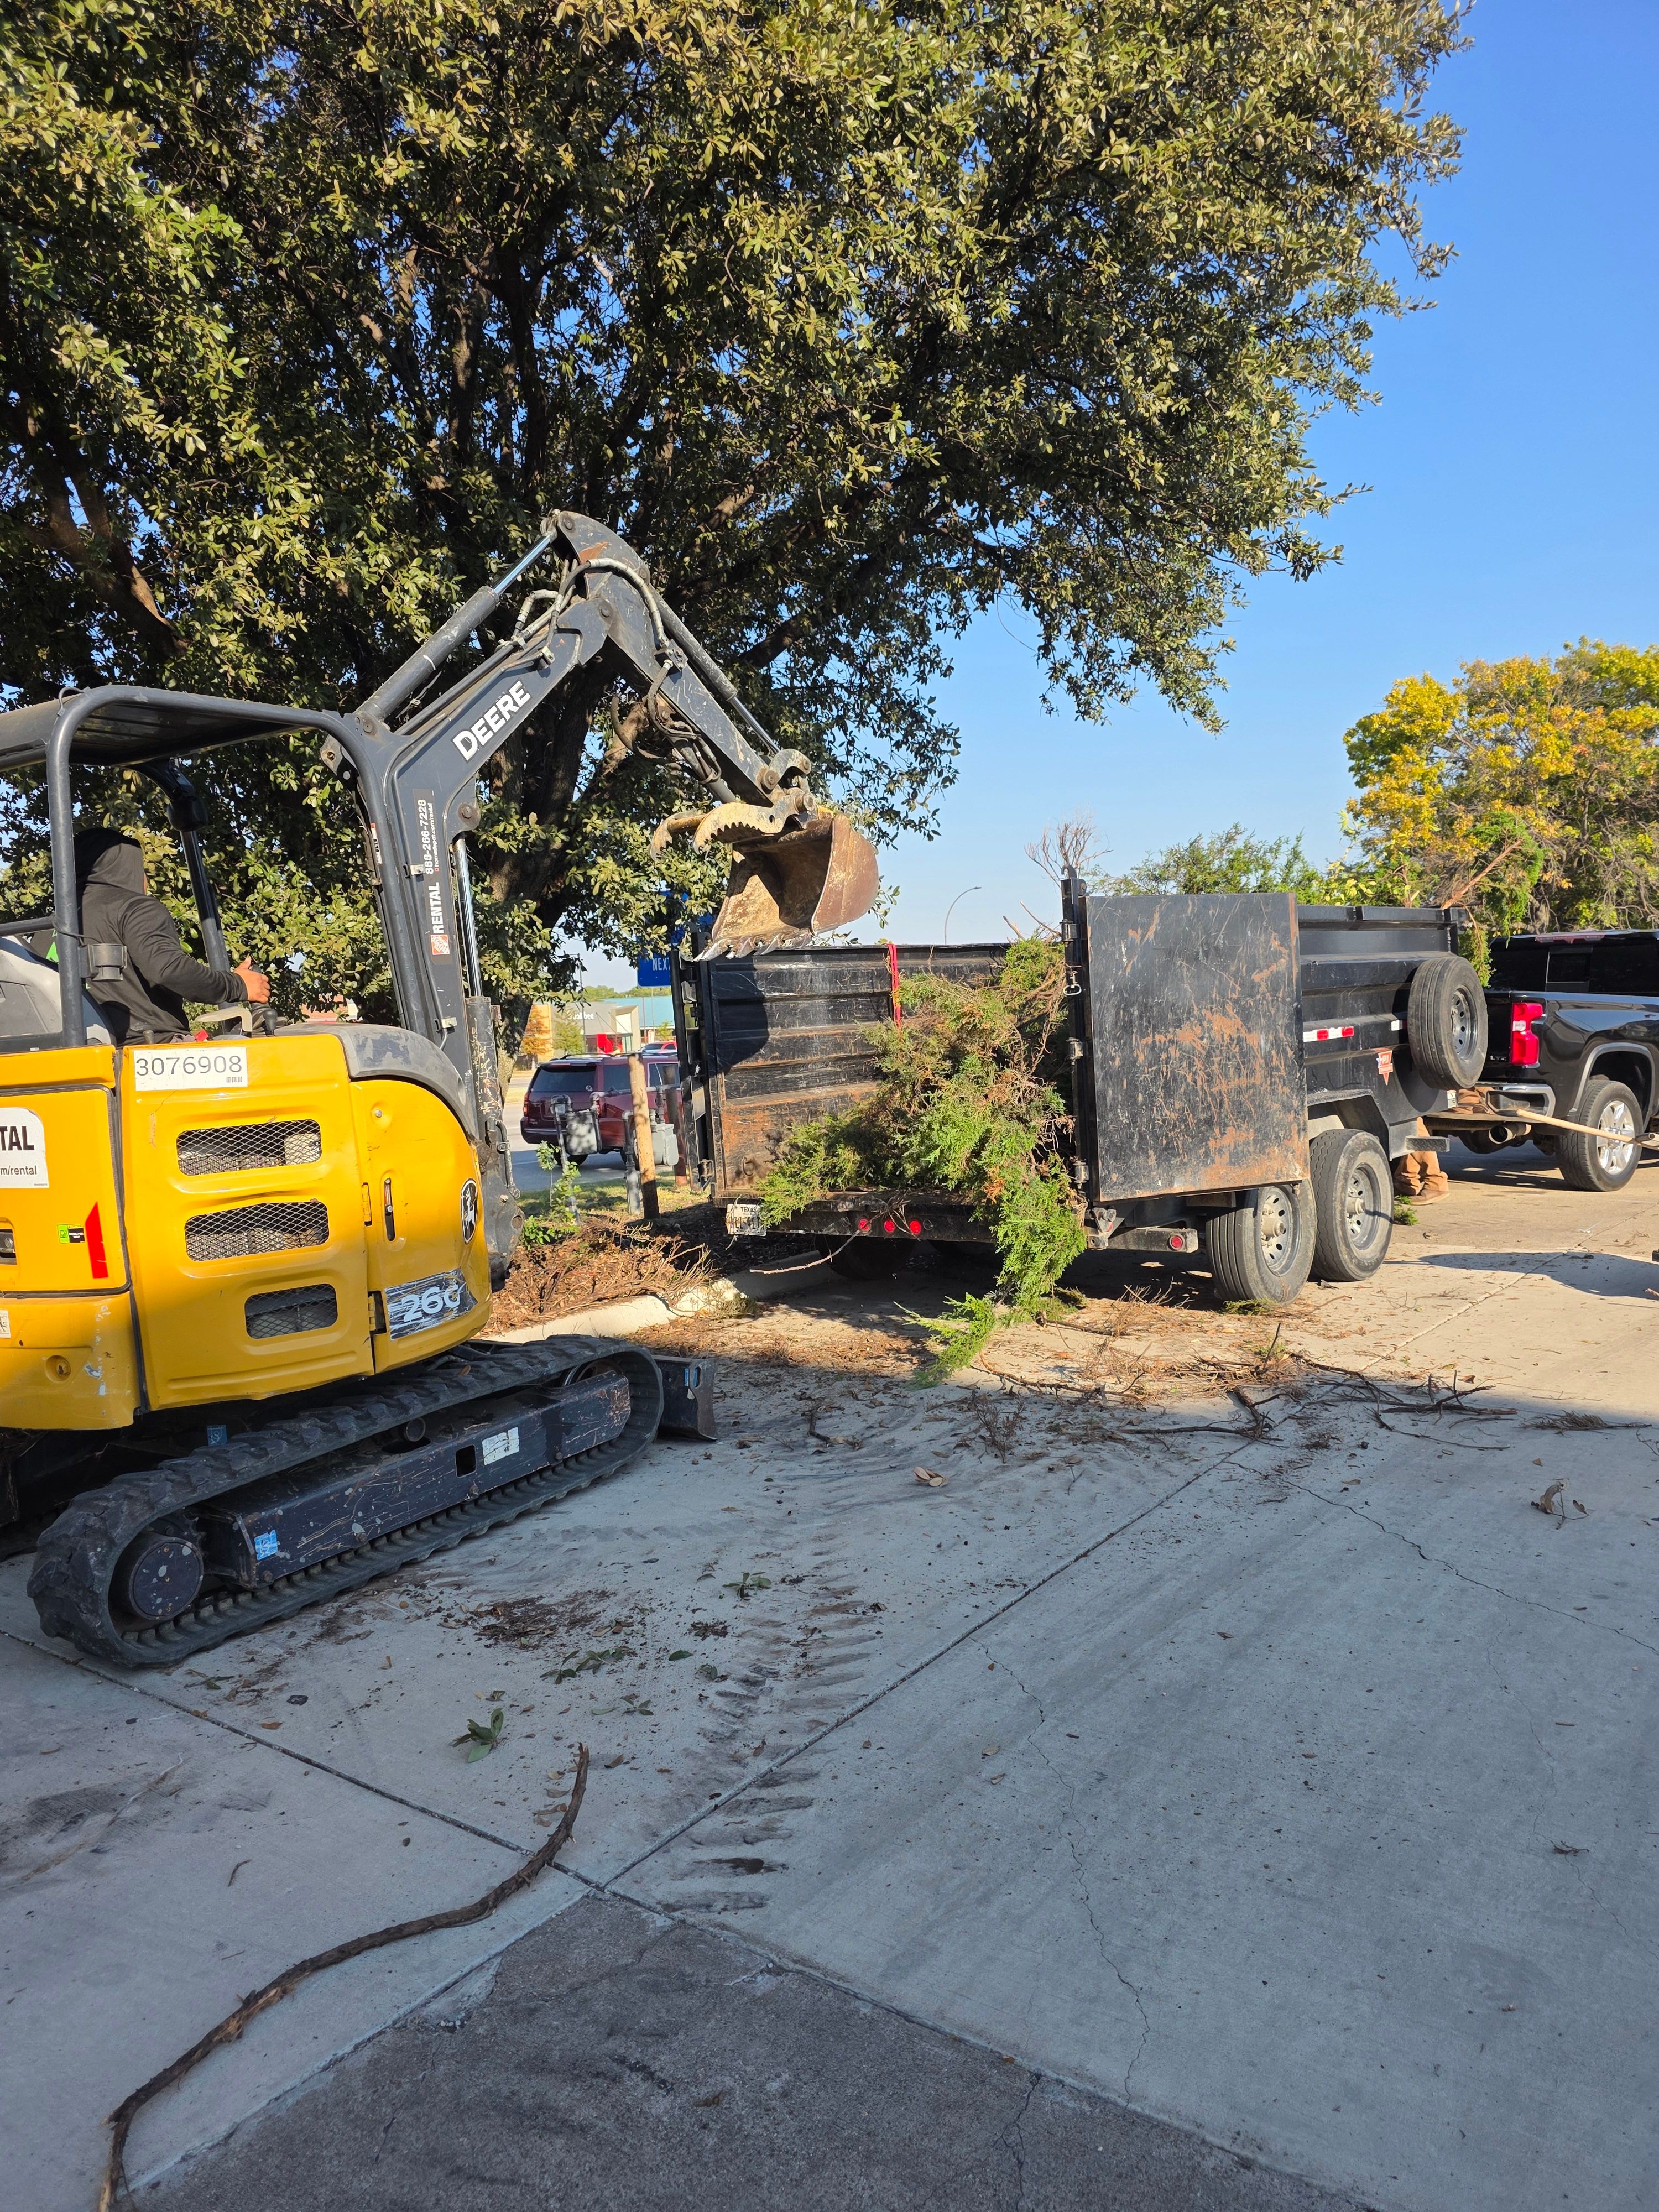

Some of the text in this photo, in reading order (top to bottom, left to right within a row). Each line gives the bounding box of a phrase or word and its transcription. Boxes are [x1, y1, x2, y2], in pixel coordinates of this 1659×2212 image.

[452, 680, 531, 761] DEERE
[418, 799, 434, 874] 888-266-7228
[428, 882, 444, 934] RENTAL
[136, 1055, 242, 1076] 3076908
